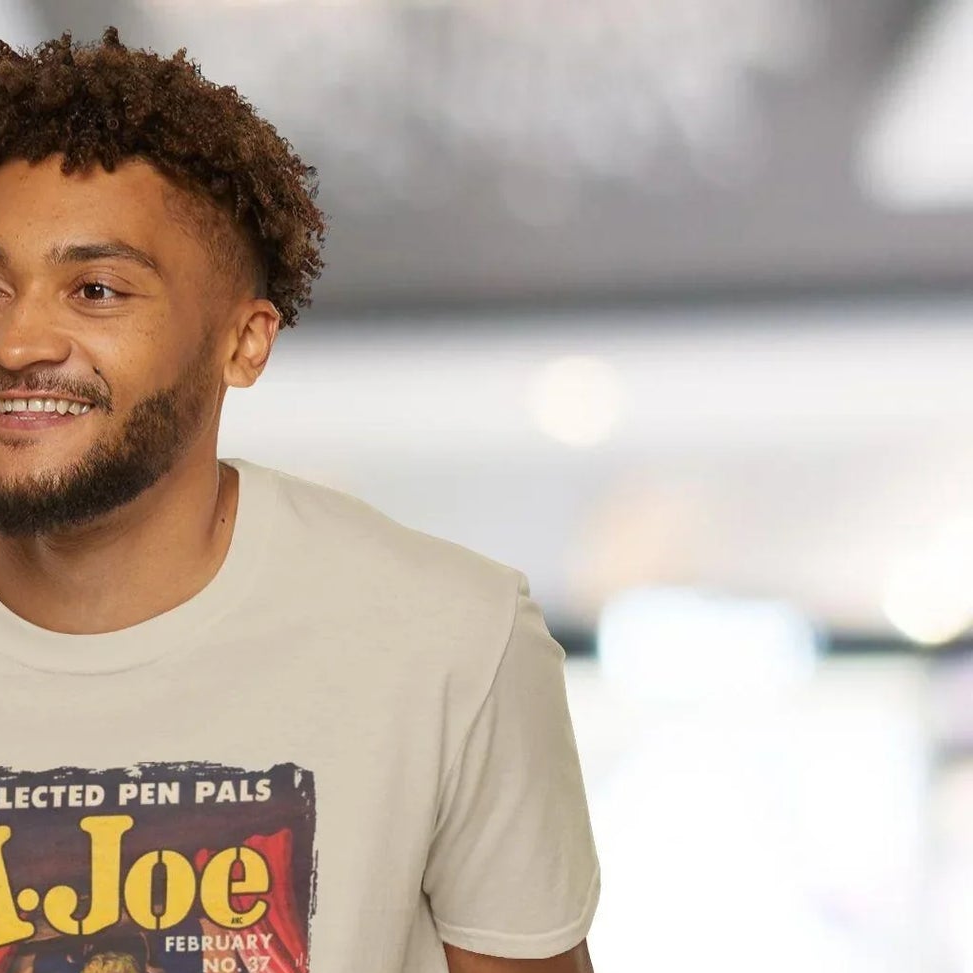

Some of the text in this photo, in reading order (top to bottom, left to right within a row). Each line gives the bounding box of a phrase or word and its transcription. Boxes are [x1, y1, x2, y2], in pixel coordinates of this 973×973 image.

[119, 781, 180, 806] PEN
[194, 779, 272, 804] PALS
[165, 933, 273, 953] FEBRUARY
[202, 956, 271, 973] NO. 37
